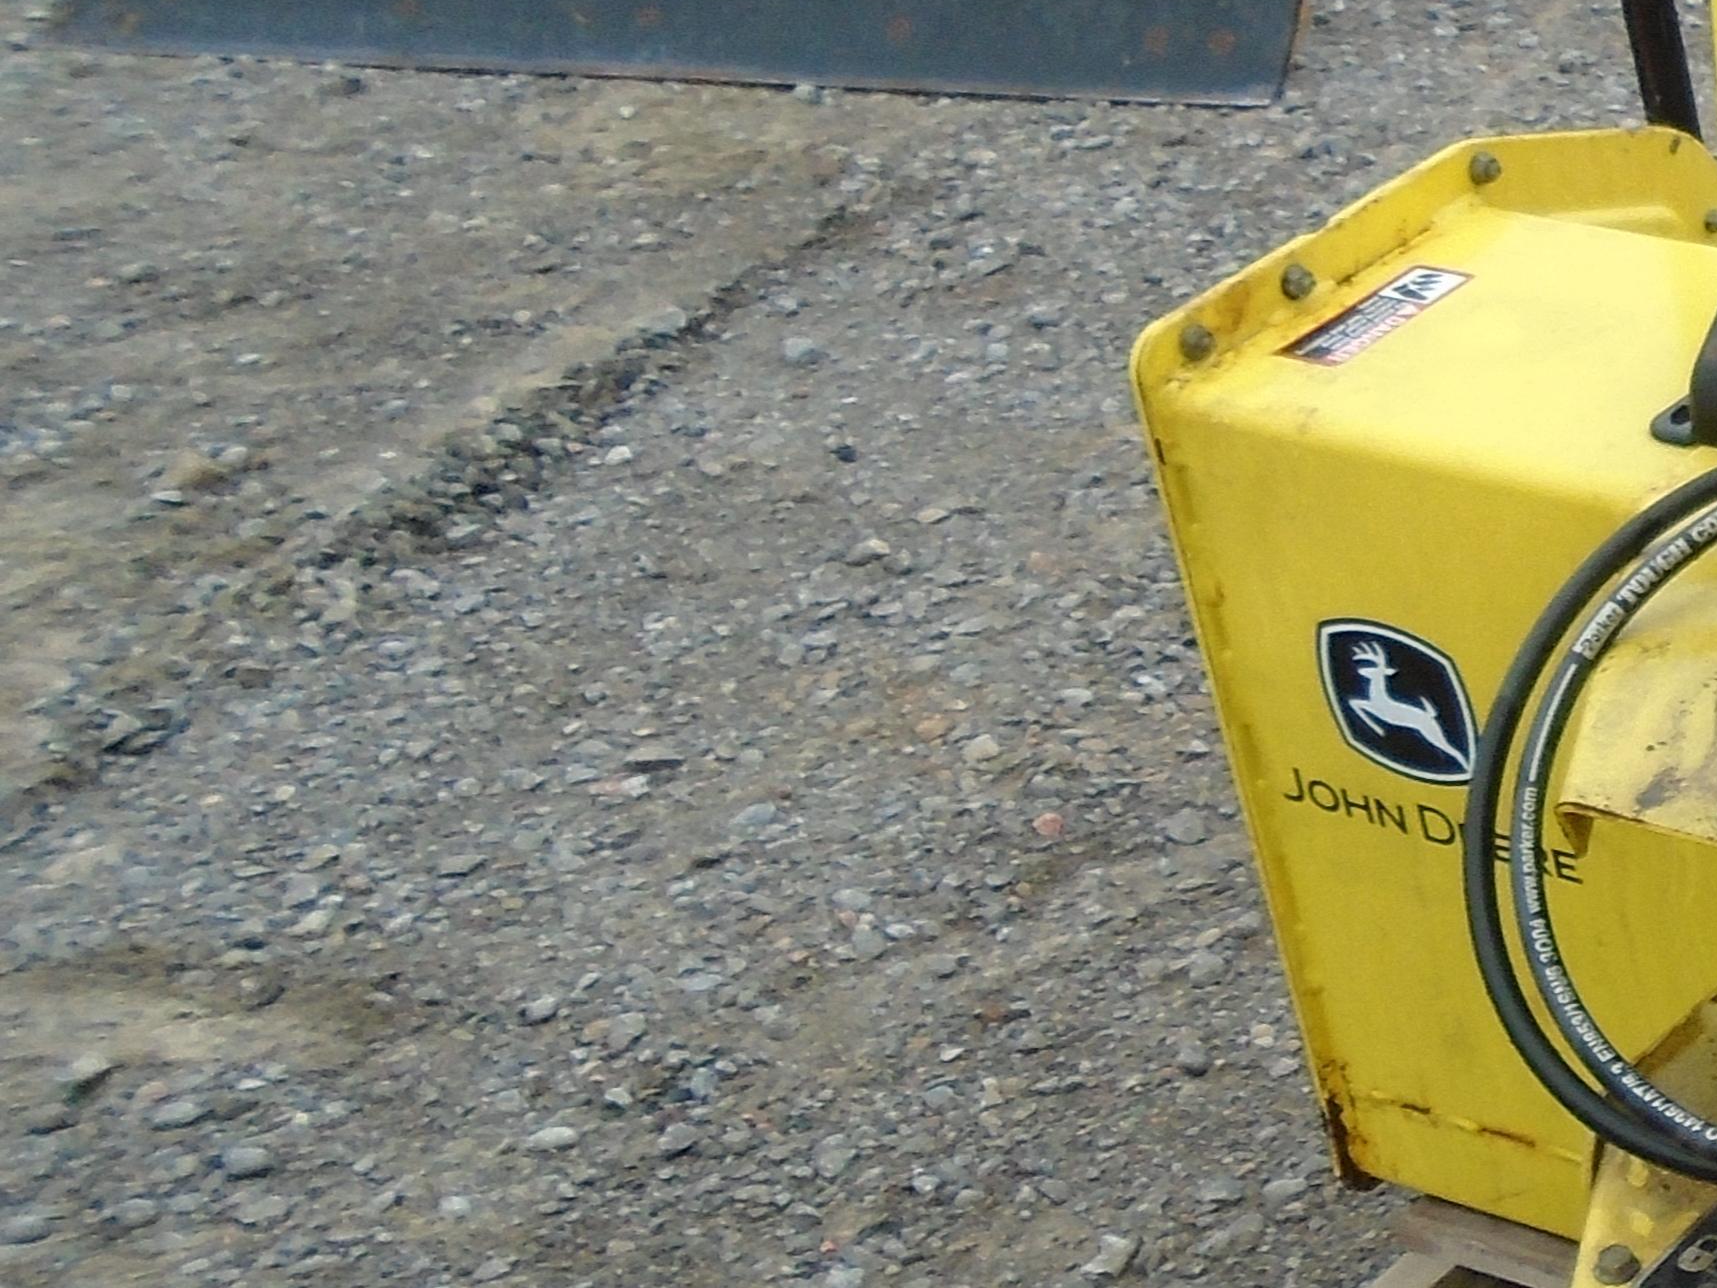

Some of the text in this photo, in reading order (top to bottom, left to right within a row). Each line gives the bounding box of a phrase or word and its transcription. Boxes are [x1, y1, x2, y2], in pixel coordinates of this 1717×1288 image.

[1573, 602, 1625, 659] Parker
[1616, 538, 1693, 603] TOUGH
[1283, 768, 1408, 835] JOHN
[1518, 784, 1543, 914] www.parker.com
